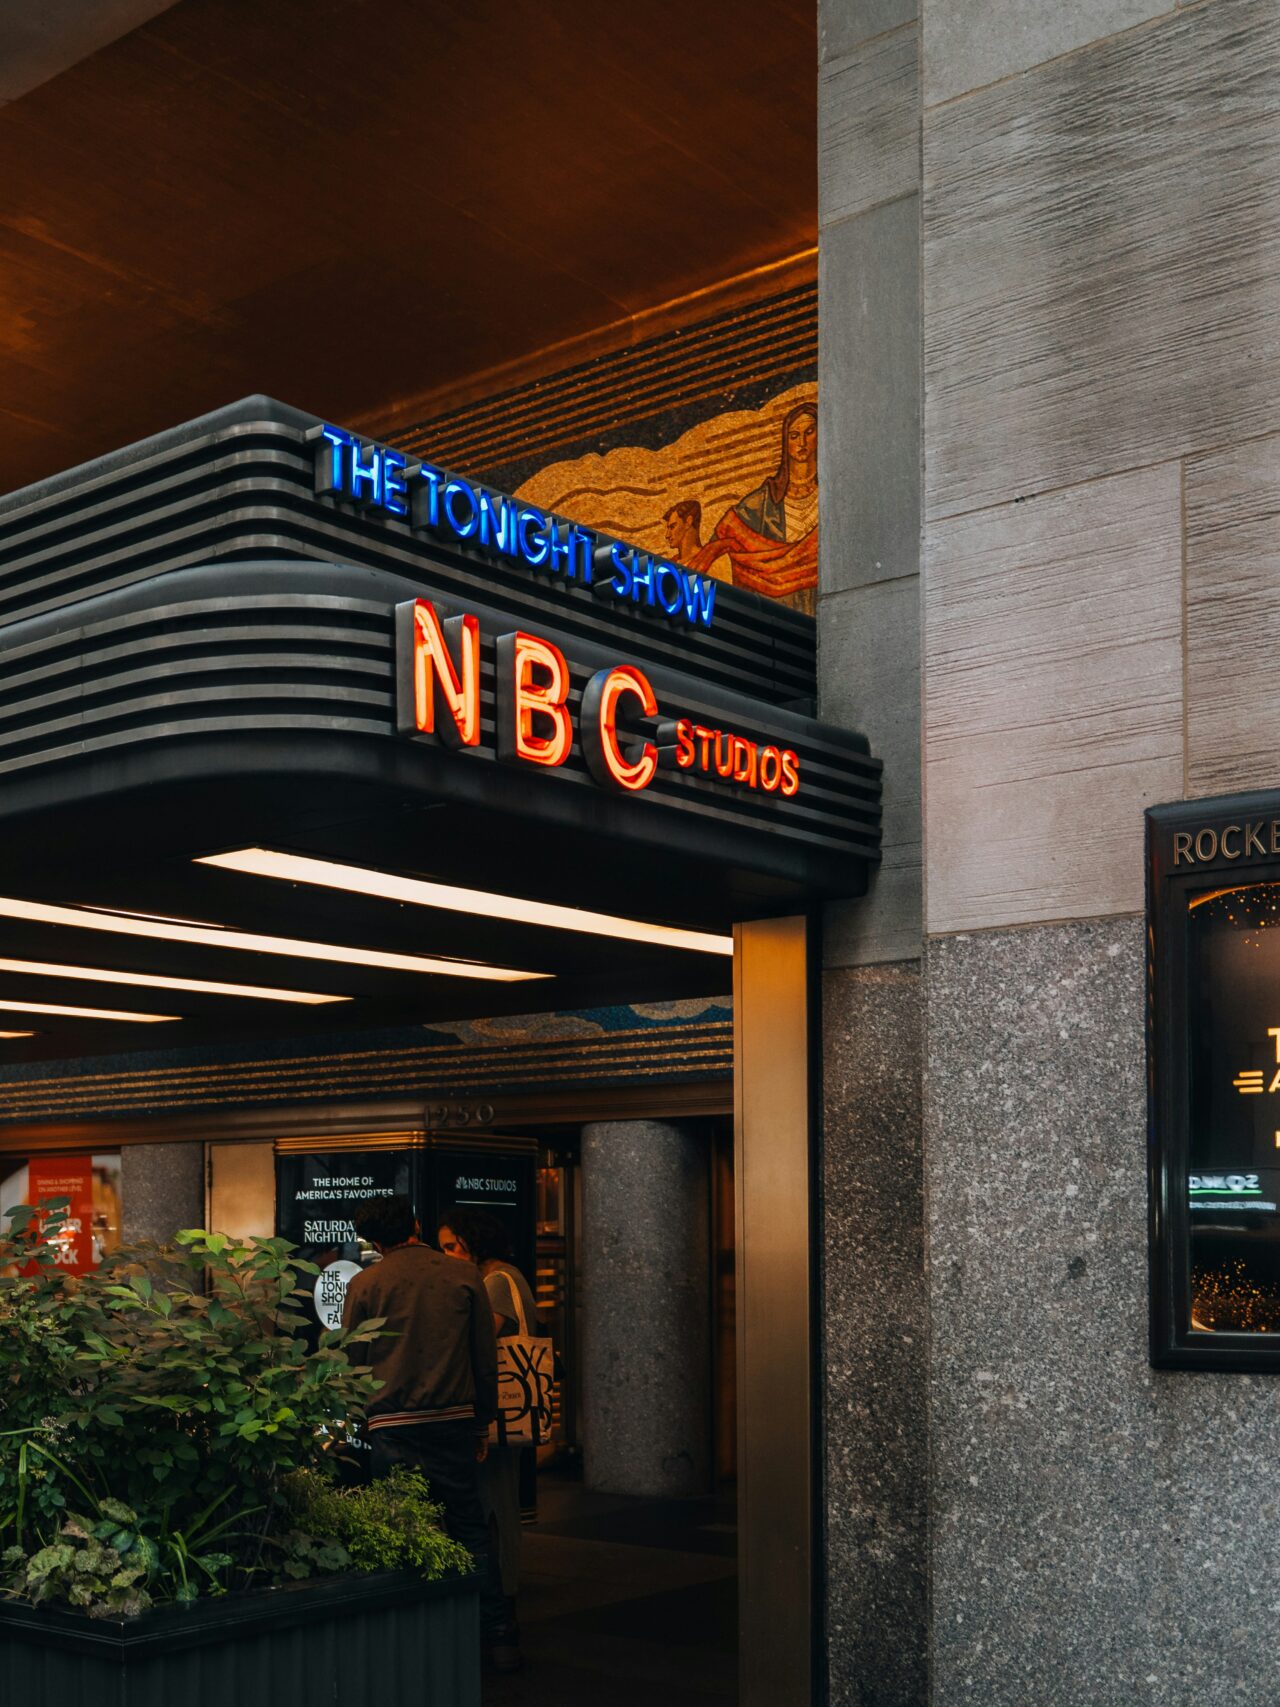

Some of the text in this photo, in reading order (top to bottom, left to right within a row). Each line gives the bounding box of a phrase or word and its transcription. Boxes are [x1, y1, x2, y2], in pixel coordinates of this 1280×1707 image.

[322, 423, 716, 628] THE TONIGHT SHOW
[414, 597, 801, 797] NBC STUDIOS
[424, 1103, 495, 1127] 1250
[312, 1176, 375, 1187] THE HOME OF
[468, 1178, 517, 1193] NBC STUDIOS
[295, 1188, 394, 1200] AMERICA'S FAVORITES
[304, 1220, 356, 1232] SATURDA
[322, 1270, 341, 1282] THE
